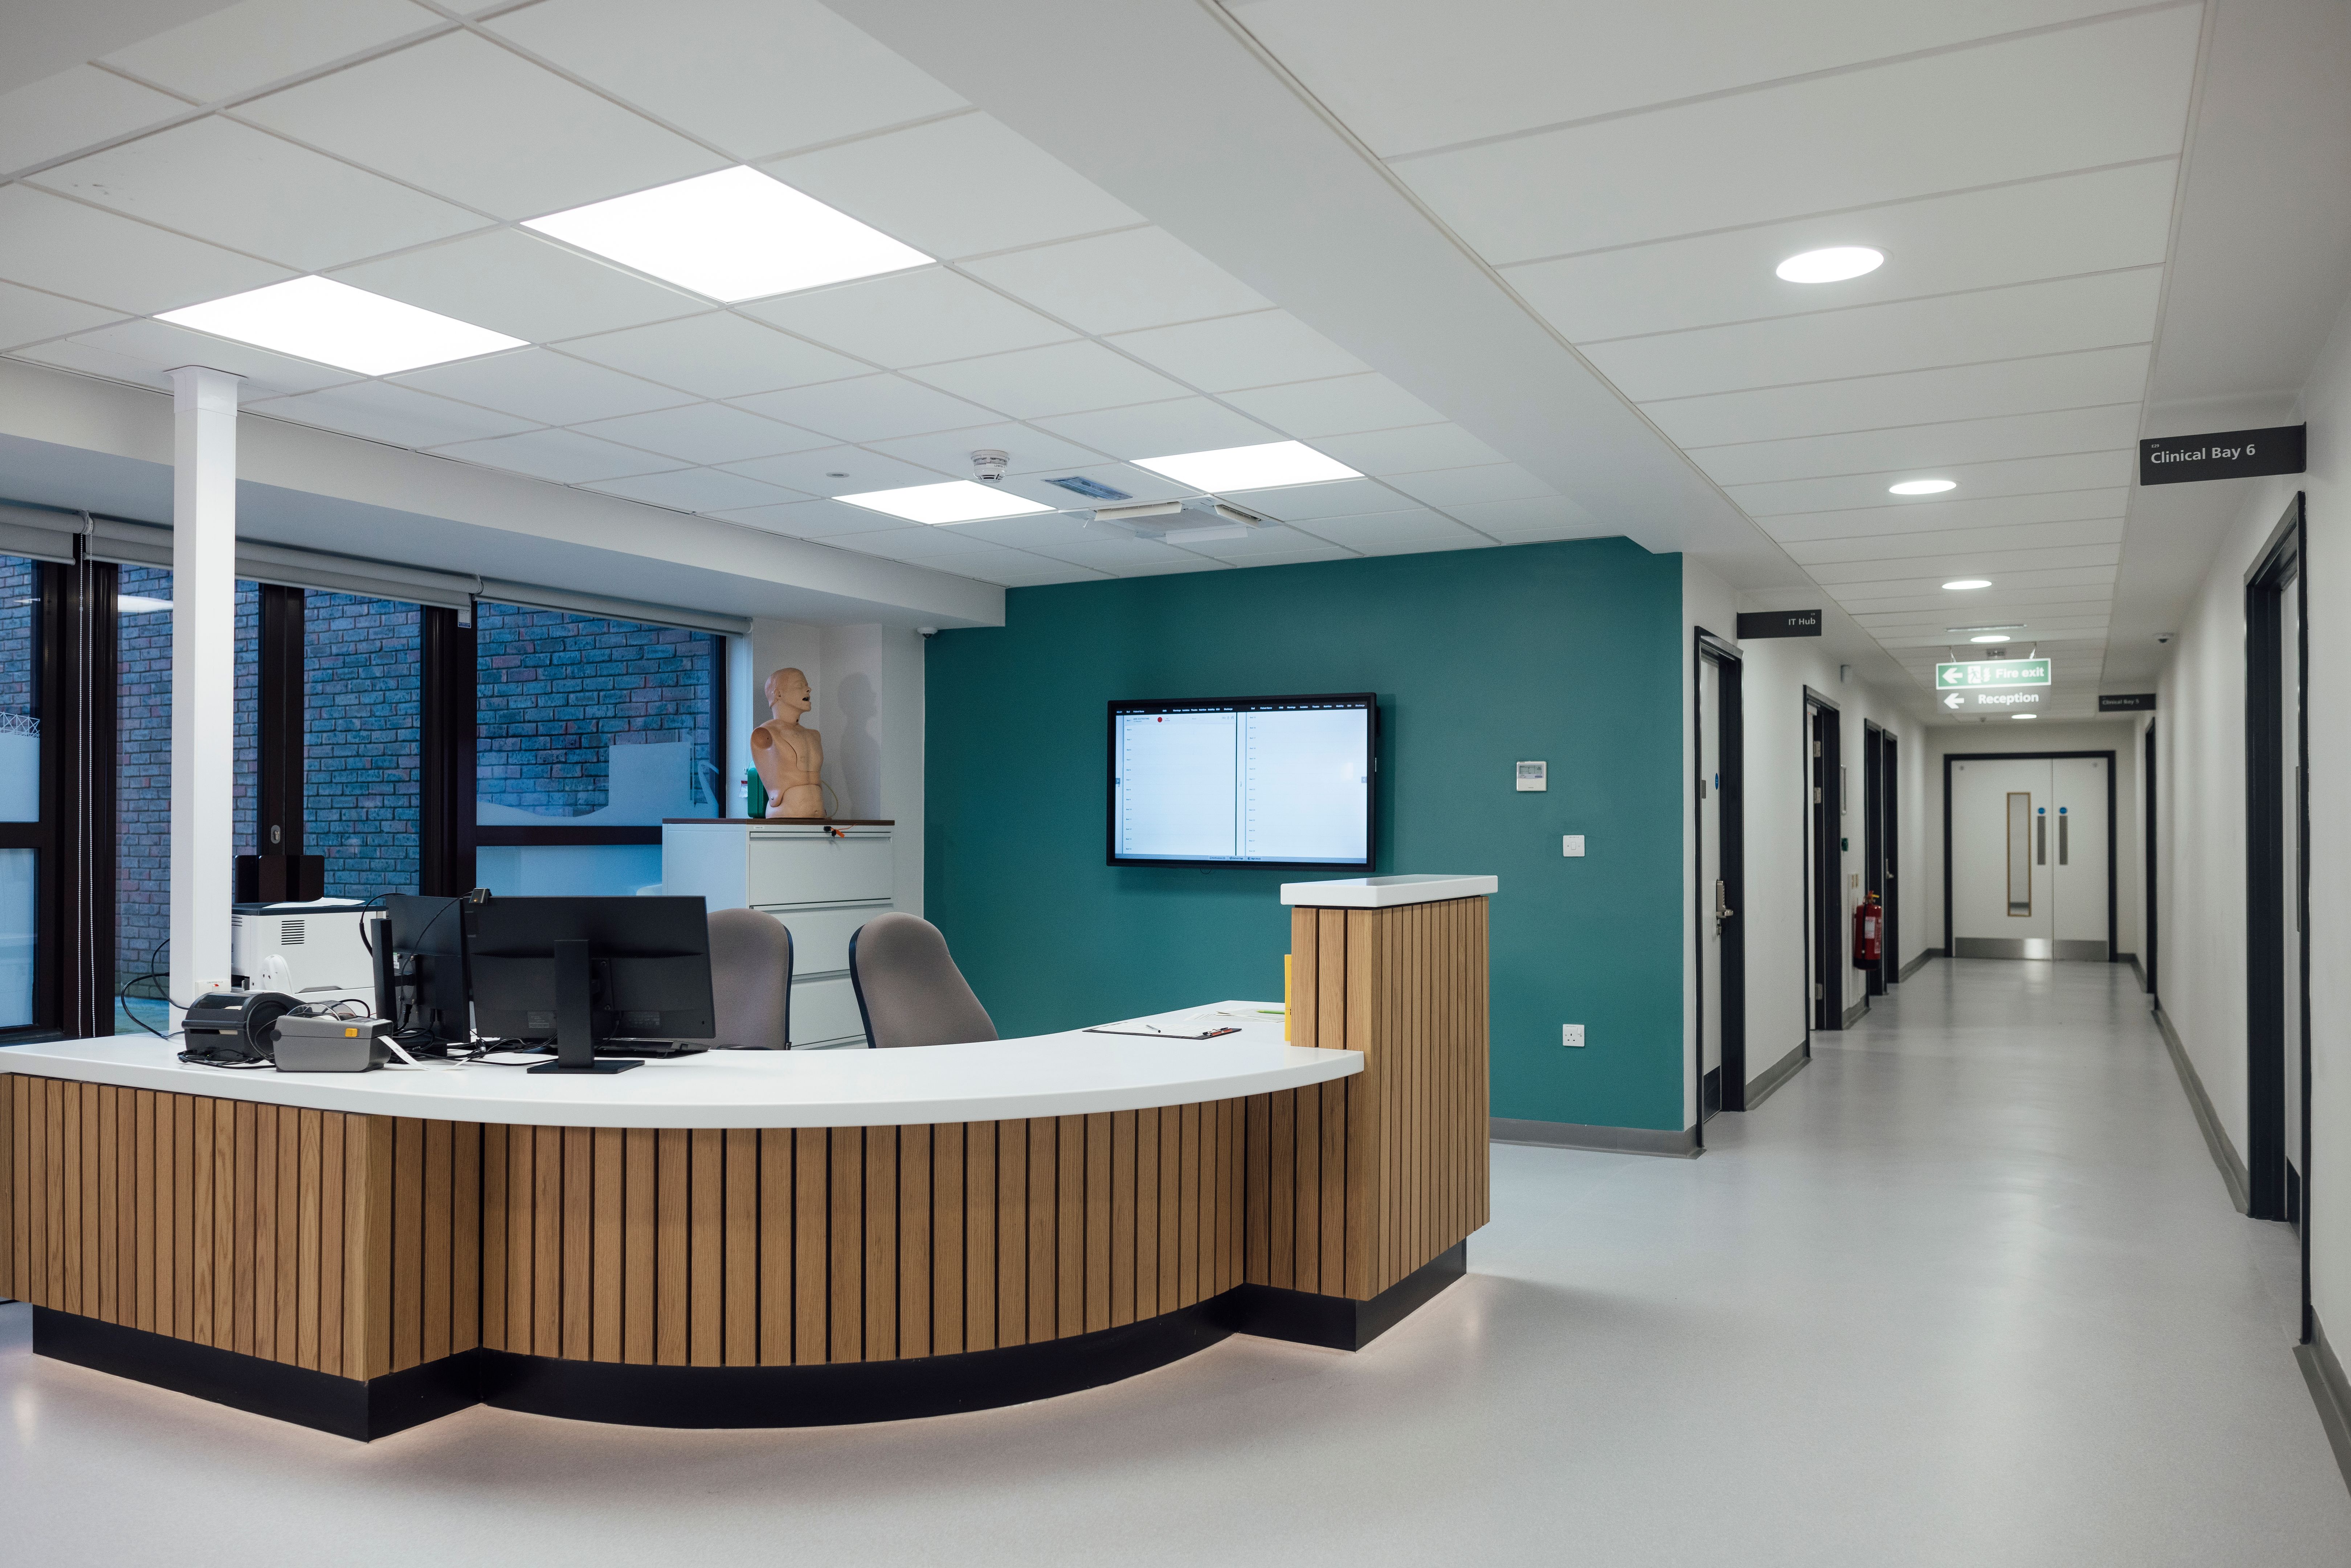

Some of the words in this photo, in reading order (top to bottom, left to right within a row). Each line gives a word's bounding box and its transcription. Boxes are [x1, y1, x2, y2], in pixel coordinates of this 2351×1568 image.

[2151, 448, 2205, 463] Clinical
[2212, 448, 2241, 460] Bay
[2246, 444, 2256, 456] 6
[1996, 668, 2019, 678] Fire
[2022, 667, 2044, 677] exit
[1978, 693, 2039, 705] Reception
